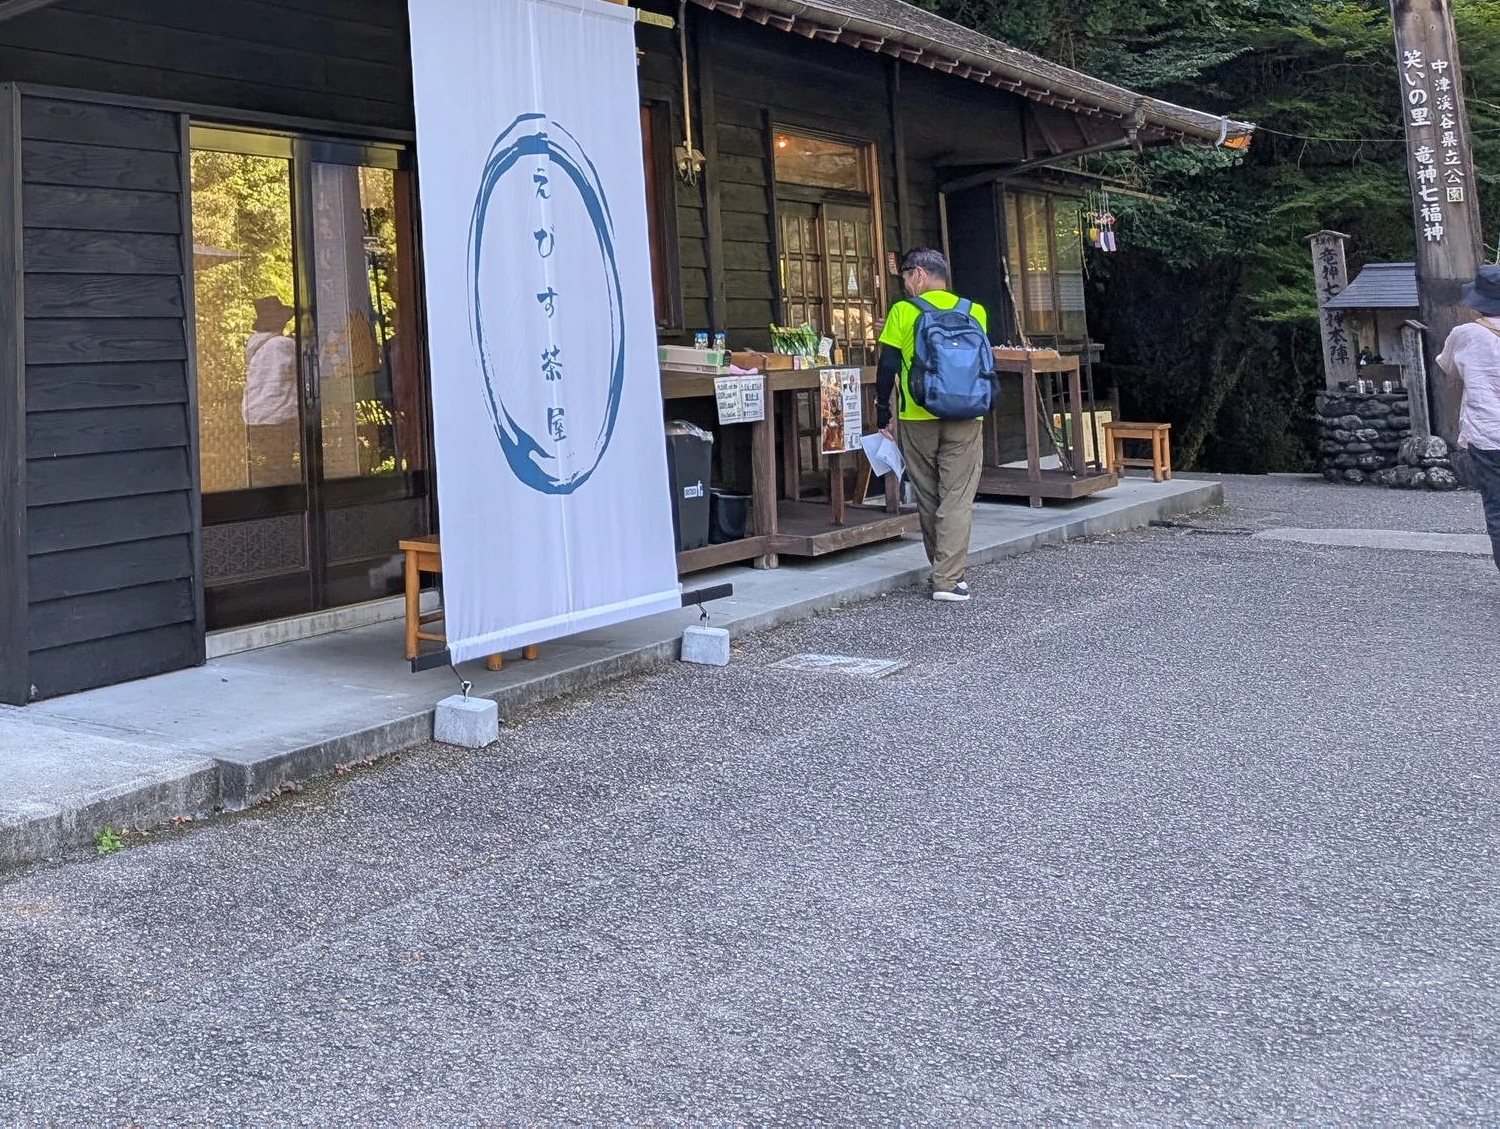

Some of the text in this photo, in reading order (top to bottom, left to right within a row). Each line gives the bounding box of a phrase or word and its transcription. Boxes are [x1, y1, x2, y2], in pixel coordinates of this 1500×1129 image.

[1404, 49, 1444, 242] 笑いの里 竜神七福神
[1431, 59, 1464, 203] 中津渓谷県立公園
[533, 167, 567, 442] えびす茶屋
[1319, 247, 1349, 364] 竜神七神本陣
